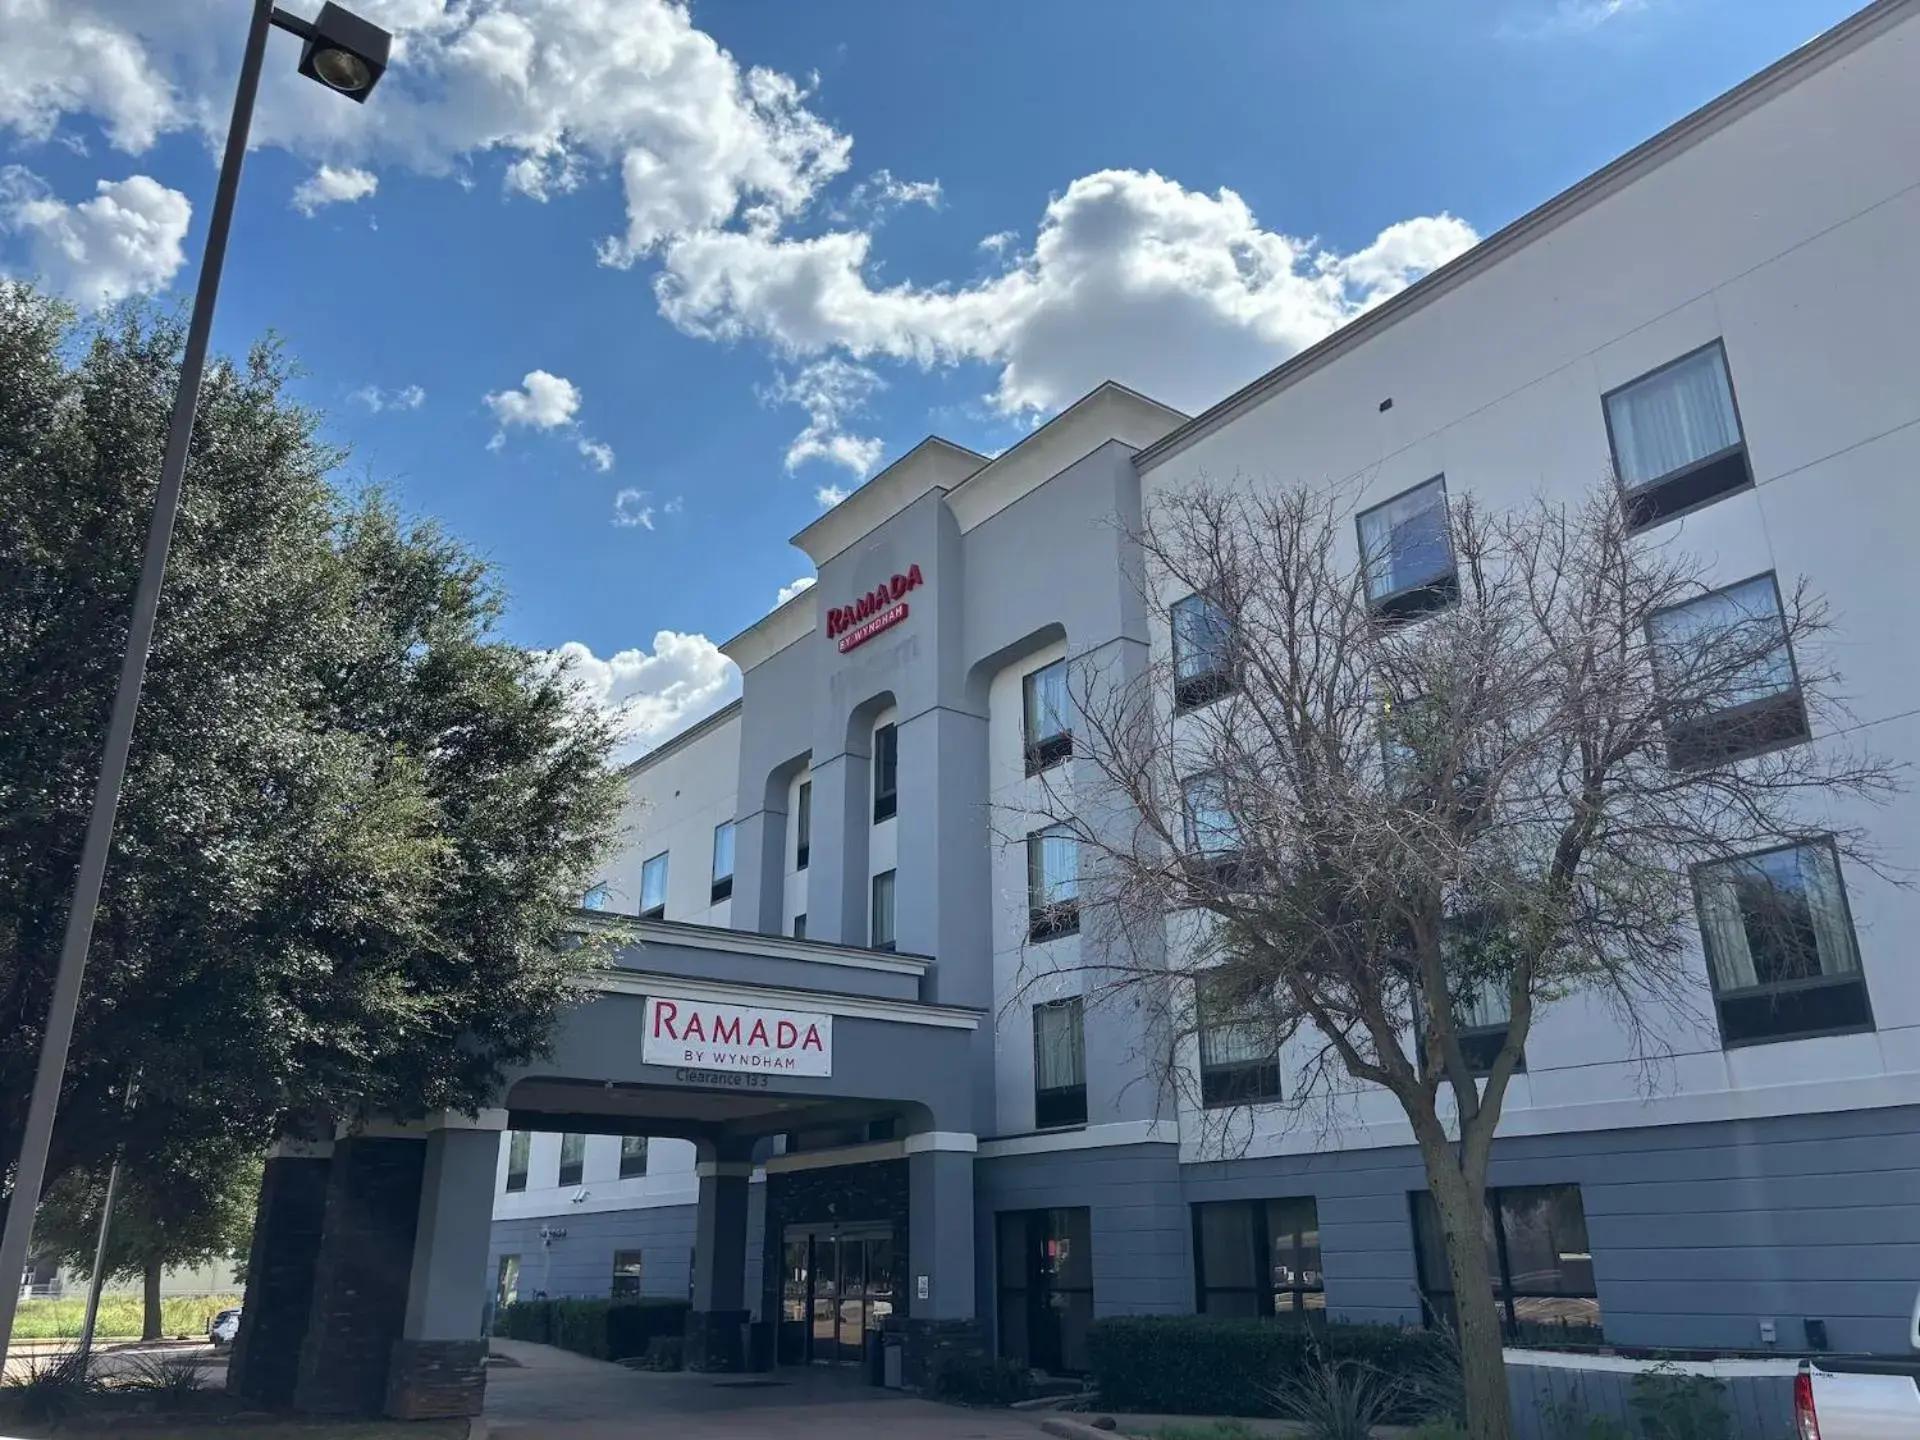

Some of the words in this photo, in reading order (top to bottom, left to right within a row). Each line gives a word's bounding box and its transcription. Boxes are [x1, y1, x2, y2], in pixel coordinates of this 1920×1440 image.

[827, 563, 924, 639] RAMADA
[839, 637, 851, 652] BY
[854, 603, 903, 641] WYNDHAM
[654, 1001, 823, 1051] RAMADA
[676, 1067, 742, 1087] Clearance
[684, 1050, 704, 1062] BY
[713, 1053, 795, 1070] WYNDHAM
